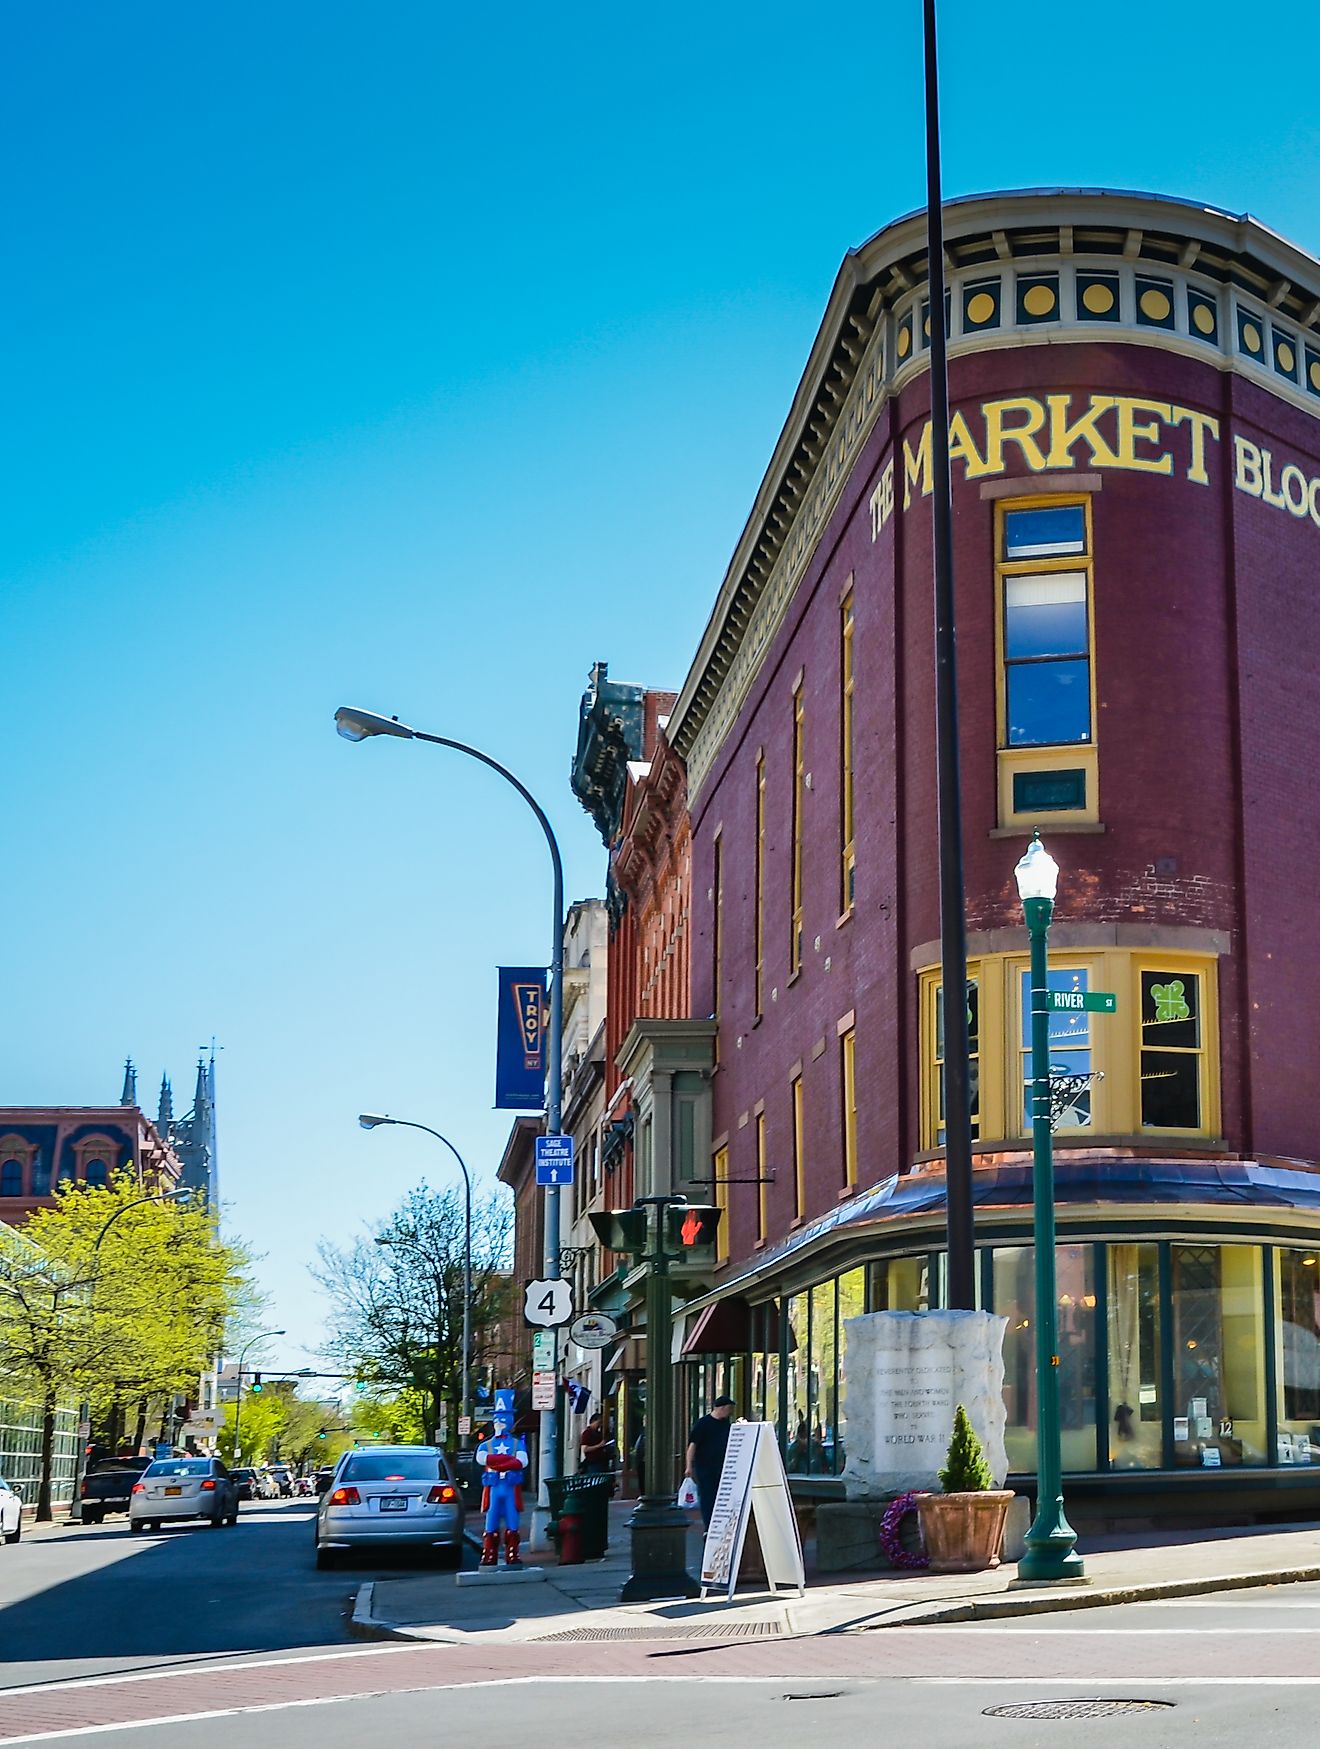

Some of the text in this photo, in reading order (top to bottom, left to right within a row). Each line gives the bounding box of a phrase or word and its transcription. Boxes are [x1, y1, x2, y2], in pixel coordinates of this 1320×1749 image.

[869, 456, 894, 544] THE
[902, 394, 1220, 512] MARKET
[1054, 992, 1085, 1009] RIVER
[526, 991, 538, 1044] TROY
[545, 1139, 562, 1148] SAGE
[540, 1148, 569, 1157] THEATRE
[537, 1290, 556, 1316] 4
[495, 1397, 506, 1411] A
[1219, 1422, 1233, 1437] 12
[884, 1434, 916, 1444] WORLD
[917, 1433, 935, 1444] WAR
